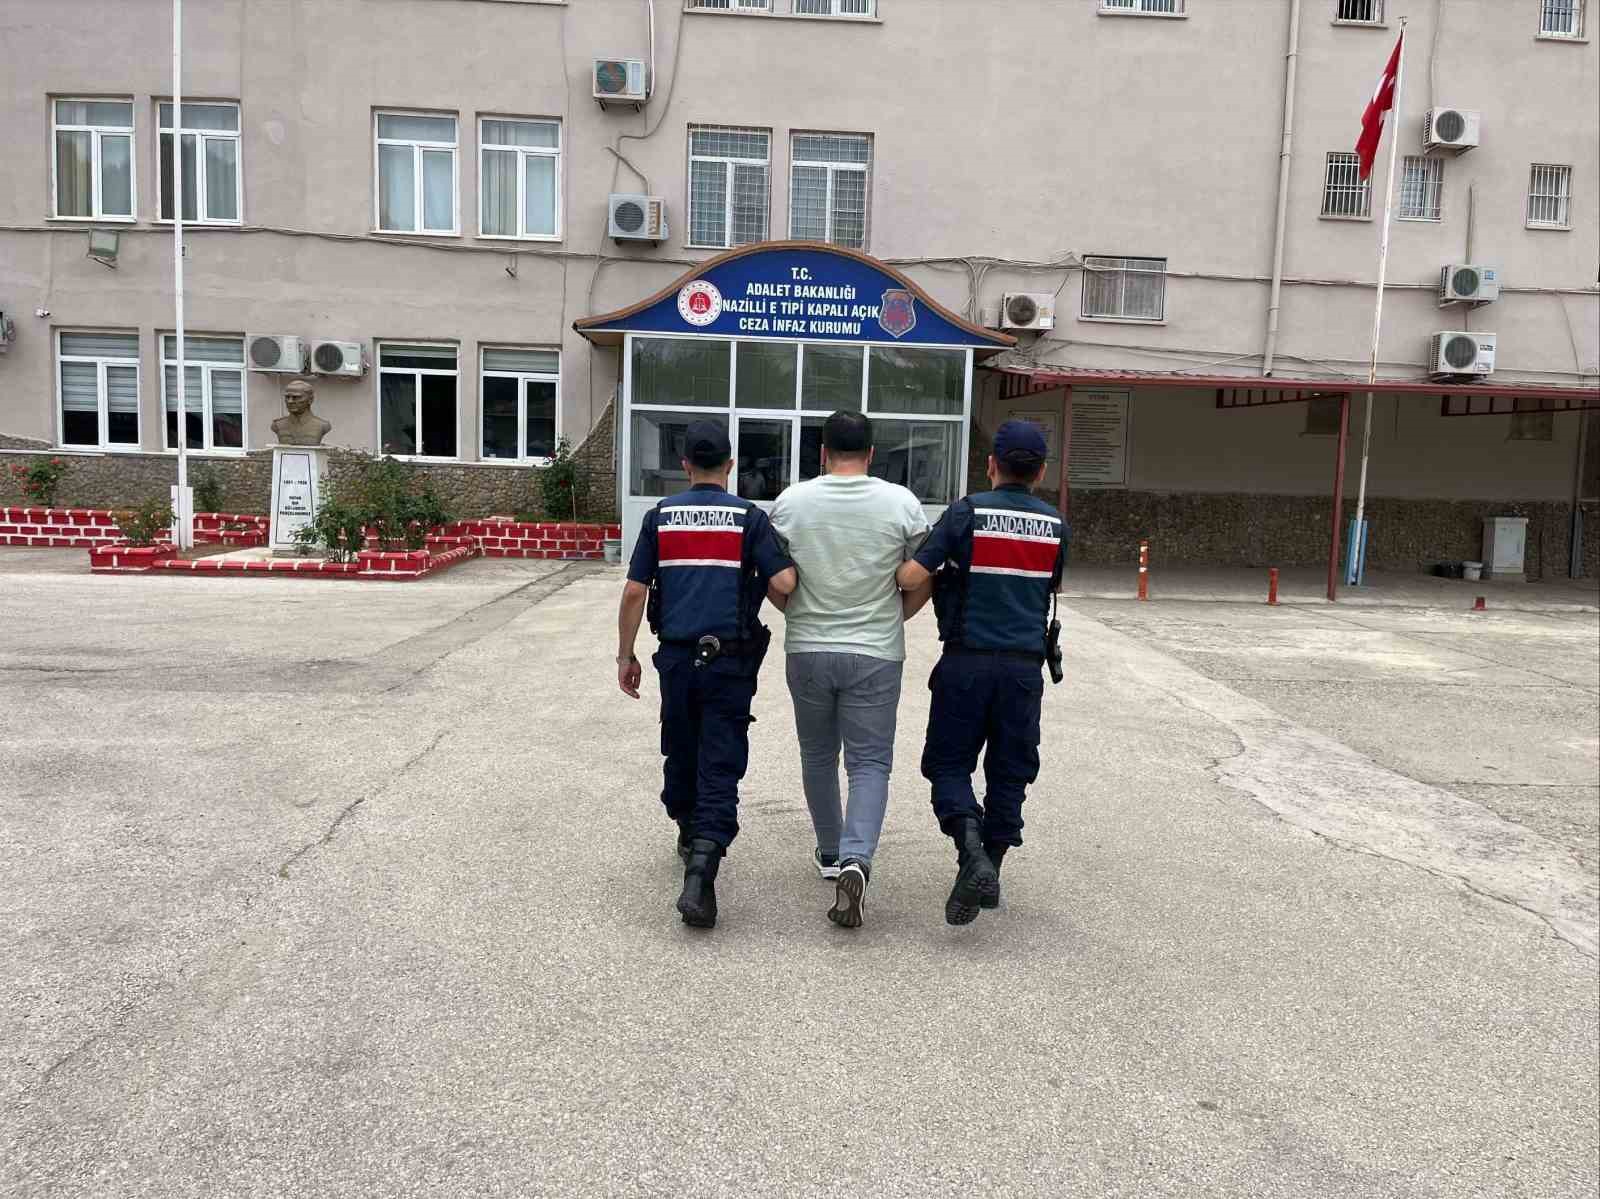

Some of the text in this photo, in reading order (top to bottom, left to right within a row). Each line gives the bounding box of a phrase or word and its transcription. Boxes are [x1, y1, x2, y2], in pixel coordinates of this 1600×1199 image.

[791, 267, 812, 280] T.C.
[746, 282, 856, 299] ADALET BAKANLIĞI
[722, 297, 879, 320] NAZİLLİ E TİPİ KAPALI AÇIK
[739, 316, 861, 335] CEZA İNFAZ KURUMU
[666, 511, 735, 526] JANDARMA
[982, 515, 1054, 538] JANDARMA
